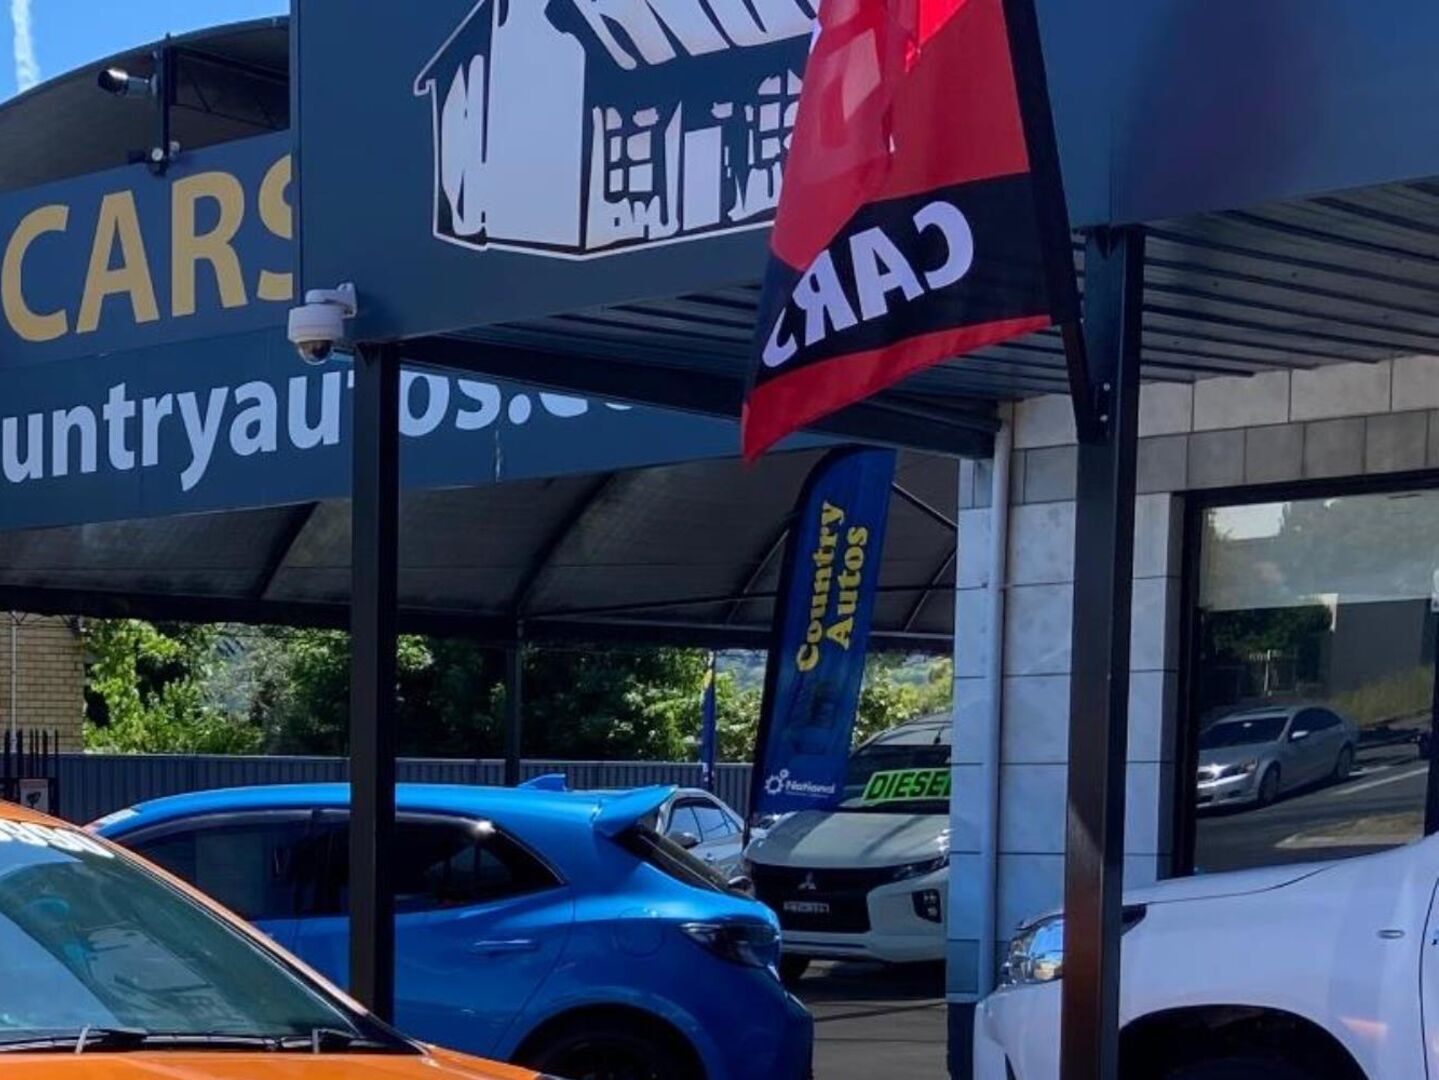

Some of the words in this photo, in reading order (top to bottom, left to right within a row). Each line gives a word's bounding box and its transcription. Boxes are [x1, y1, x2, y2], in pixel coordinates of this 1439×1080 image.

[795, 501, 845, 673] Country
[826, 525, 869, 651] Autos
[786, 780, 835, 794] National
[866, 769, 951, 800] DIESE
